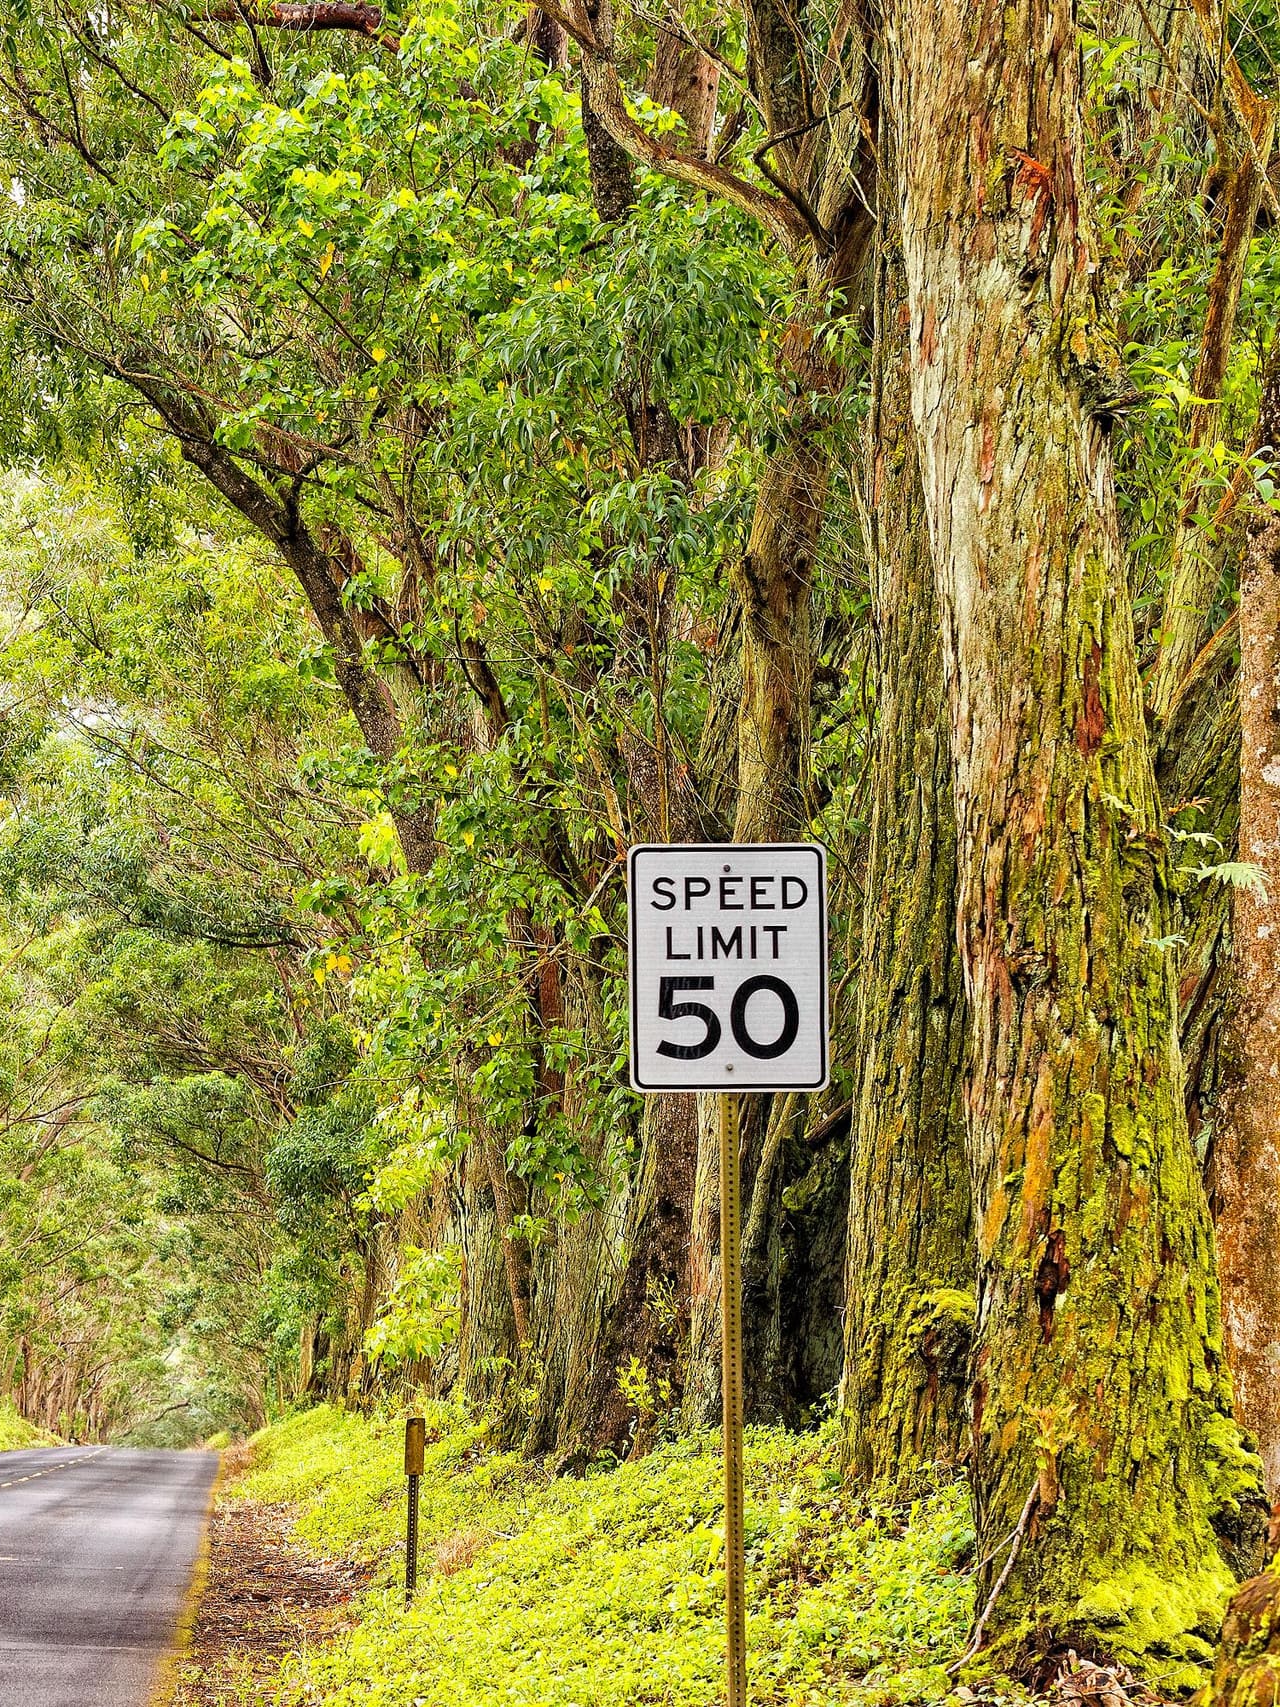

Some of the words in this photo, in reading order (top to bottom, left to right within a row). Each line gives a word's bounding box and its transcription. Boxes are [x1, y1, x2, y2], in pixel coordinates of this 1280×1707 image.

[650, 876, 809, 911] SPEED
[665, 925, 788, 960] LIMIT
[655, 974, 800, 1061] 50
